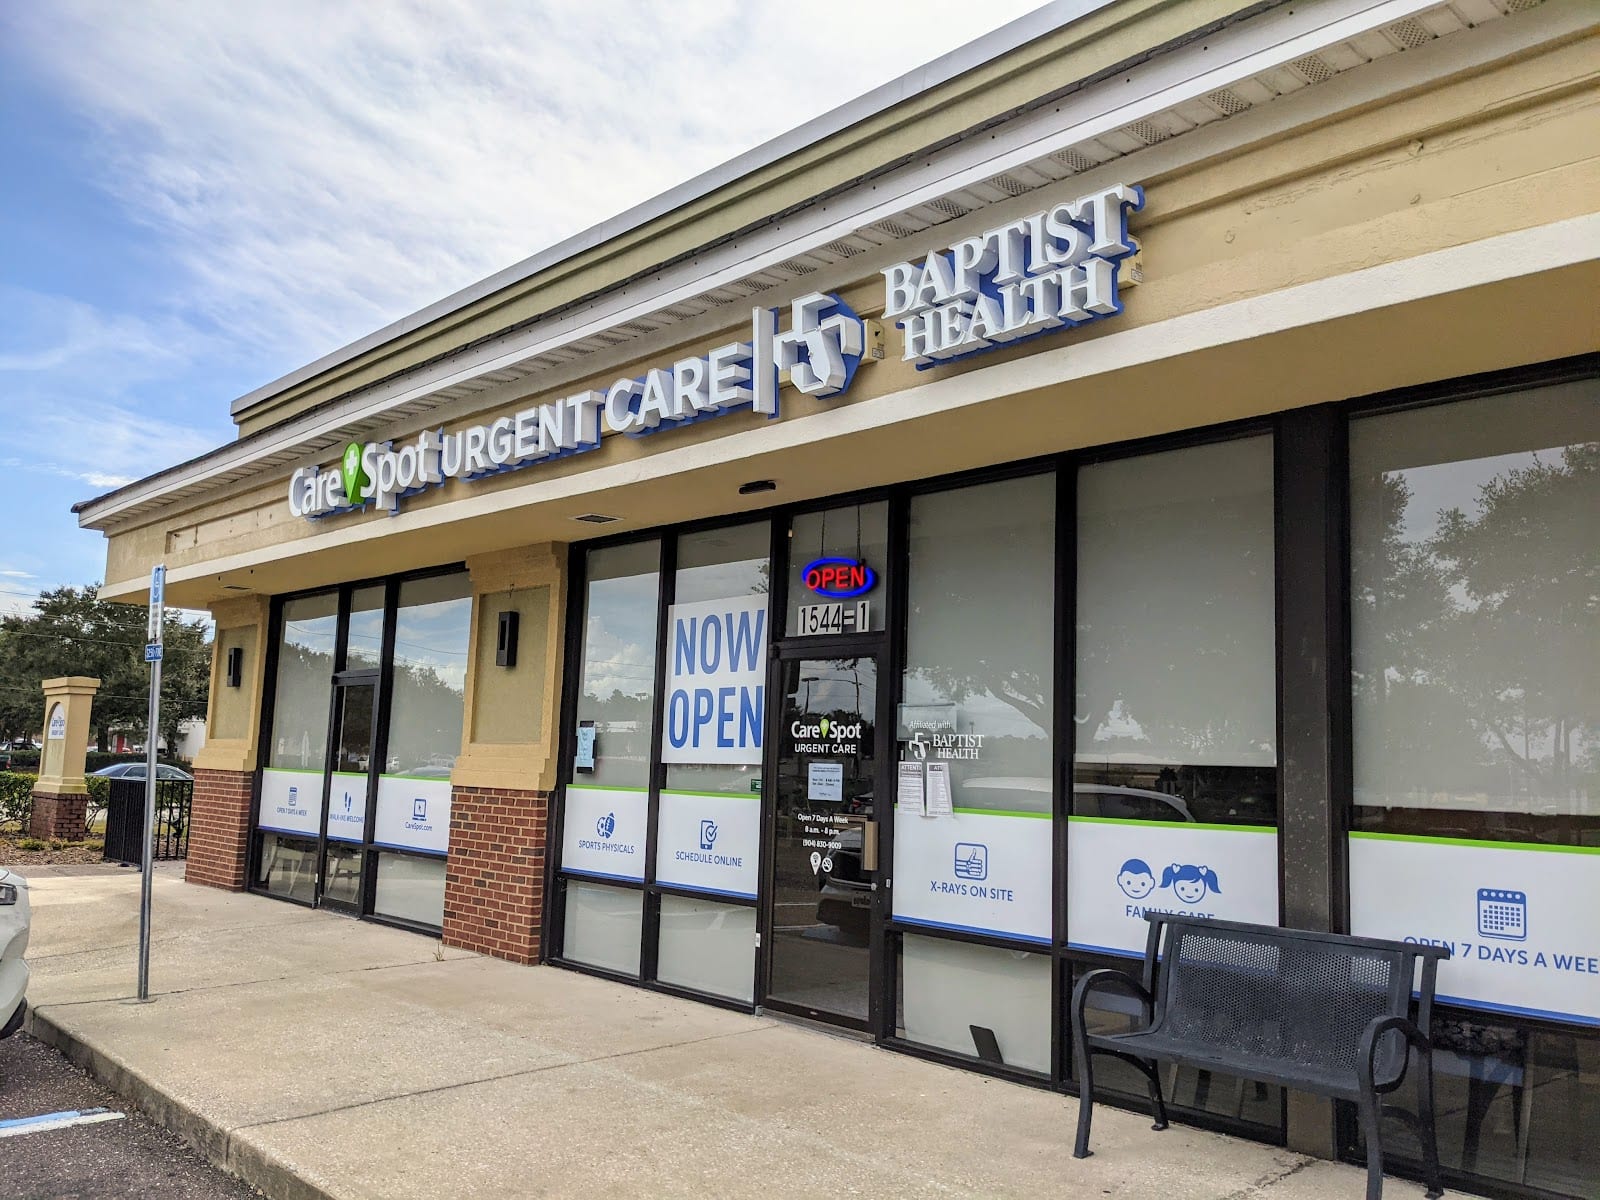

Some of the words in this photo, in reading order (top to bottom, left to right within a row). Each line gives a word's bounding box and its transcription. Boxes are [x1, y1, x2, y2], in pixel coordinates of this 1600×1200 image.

[880, 183, 1141, 320] BAPTIST
[899, 257, 1118, 362] HEALTH
[441, 390, 604, 479] URGENT
[605, 341, 753, 435] CARE
[806, 566, 865, 590] OPEN
[674, 609, 765, 676] NOW
[669, 685, 764, 749] OPEN
[937, 720, 951, 729] with
[794, 743, 830, 753] URGENT
[831, 744, 857, 754] CARE
[932, 733, 985, 748] BAPTIST
[937, 747, 980, 760] HEALTH
[797, 813, 811, 822] Open
[816, 815, 829, 824] Days
[829, 815, 834, 823] A
[834, 815, 849, 824] Week
[578, 839, 601, 851] SPORTS
[602, 842, 635, 855] PHYSICALS
[675, 850, 713, 864] SCHEDULE
[713, 855, 743, 868] ONLINE
[929, 880, 967, 897] X-RAYS
[969, 884, 988, 899] ON
[990, 887, 1014, 902] SITE
[1461, 942, 1472, 958] 7
[1478, 945, 1528, 965] DAYS
[1534, 952, 1547, 968] A
[1553, 953, 1600, 974] WEE
